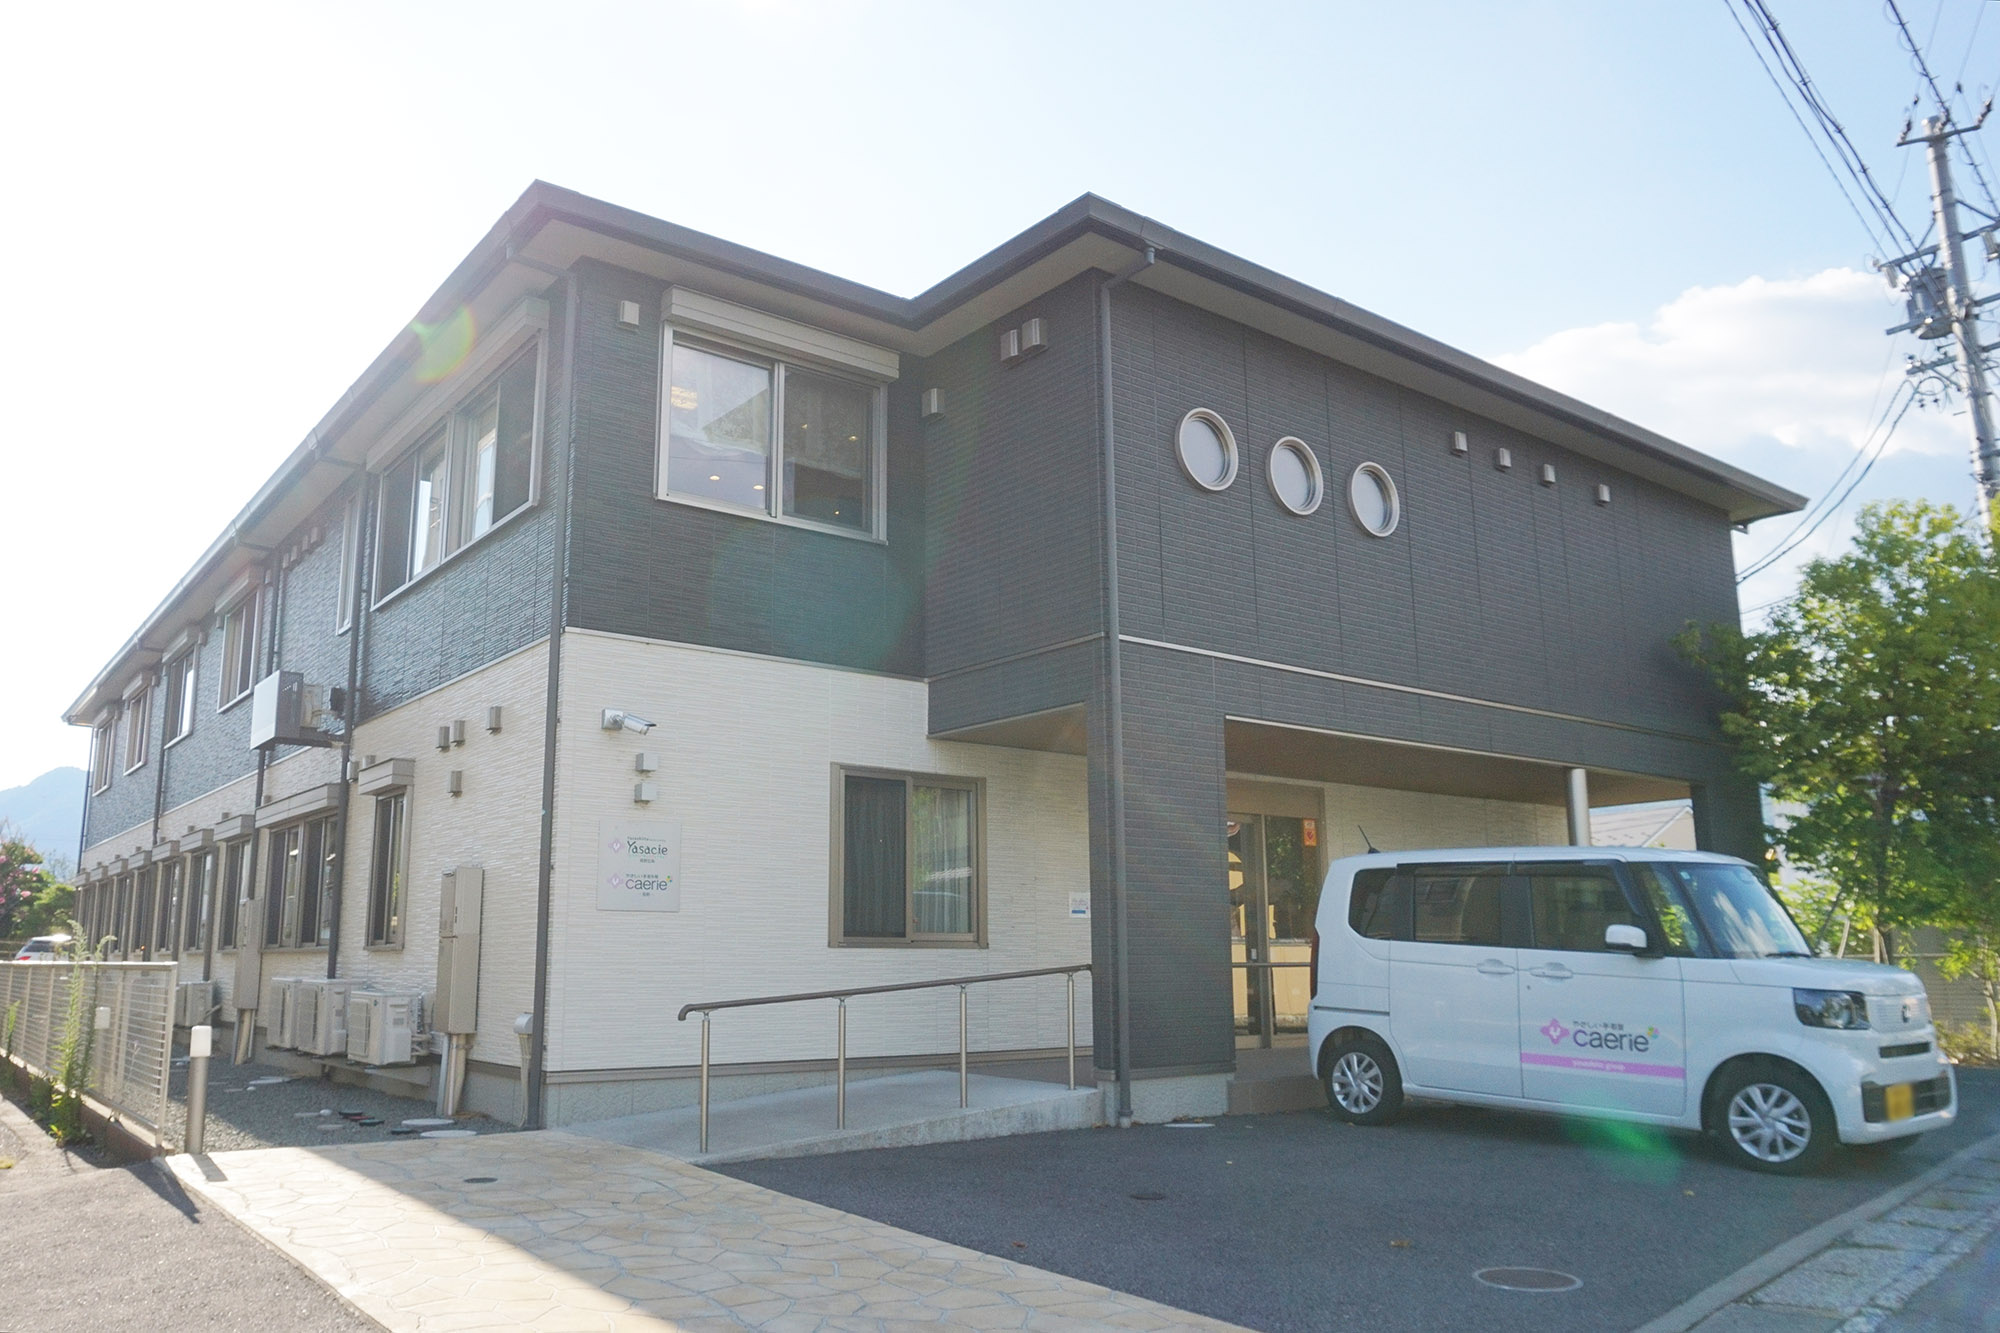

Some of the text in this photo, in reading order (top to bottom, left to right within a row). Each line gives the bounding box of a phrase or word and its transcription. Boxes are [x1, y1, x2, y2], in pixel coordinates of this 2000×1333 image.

[627, 841, 667, 855] Yasacie
[625, 879, 668, 891] caerie
[1573, 1029, 1649, 1052] caerie
